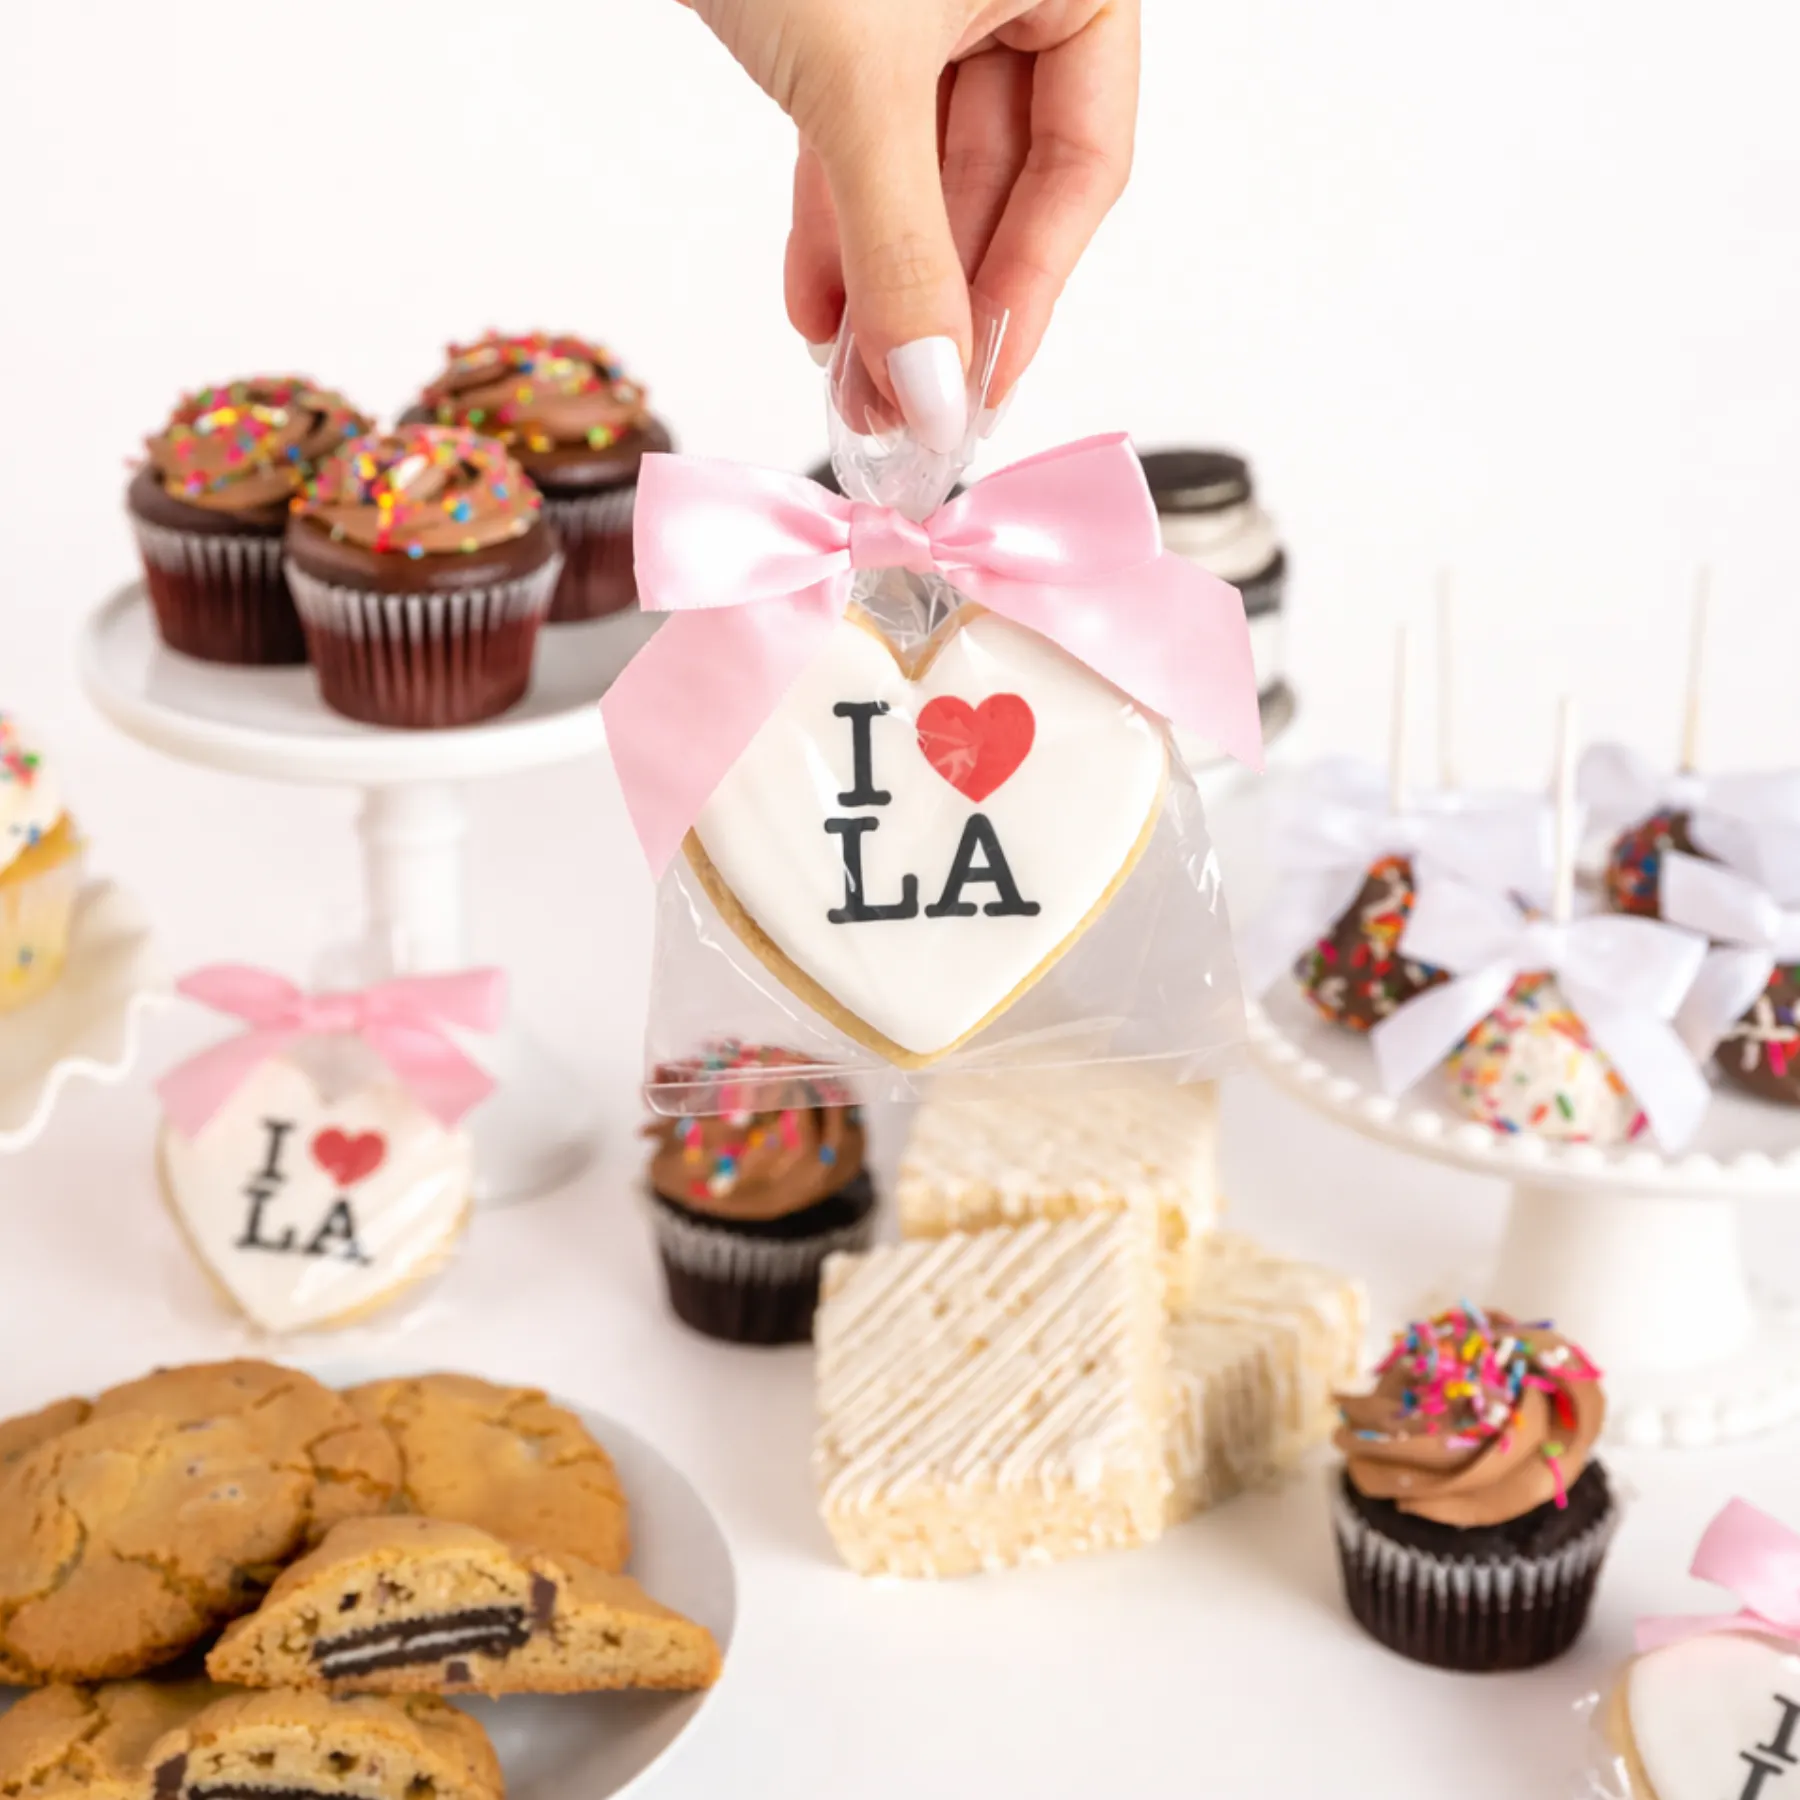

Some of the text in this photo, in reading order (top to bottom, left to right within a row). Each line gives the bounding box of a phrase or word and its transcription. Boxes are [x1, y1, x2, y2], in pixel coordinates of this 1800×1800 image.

[832, 700, 893, 808] I
[823, 812, 1042, 925] LA
[260, 1116, 296, 1183] I
[234, 1185, 373, 1267] LA
[1755, 1693, 1800, 1765] I
